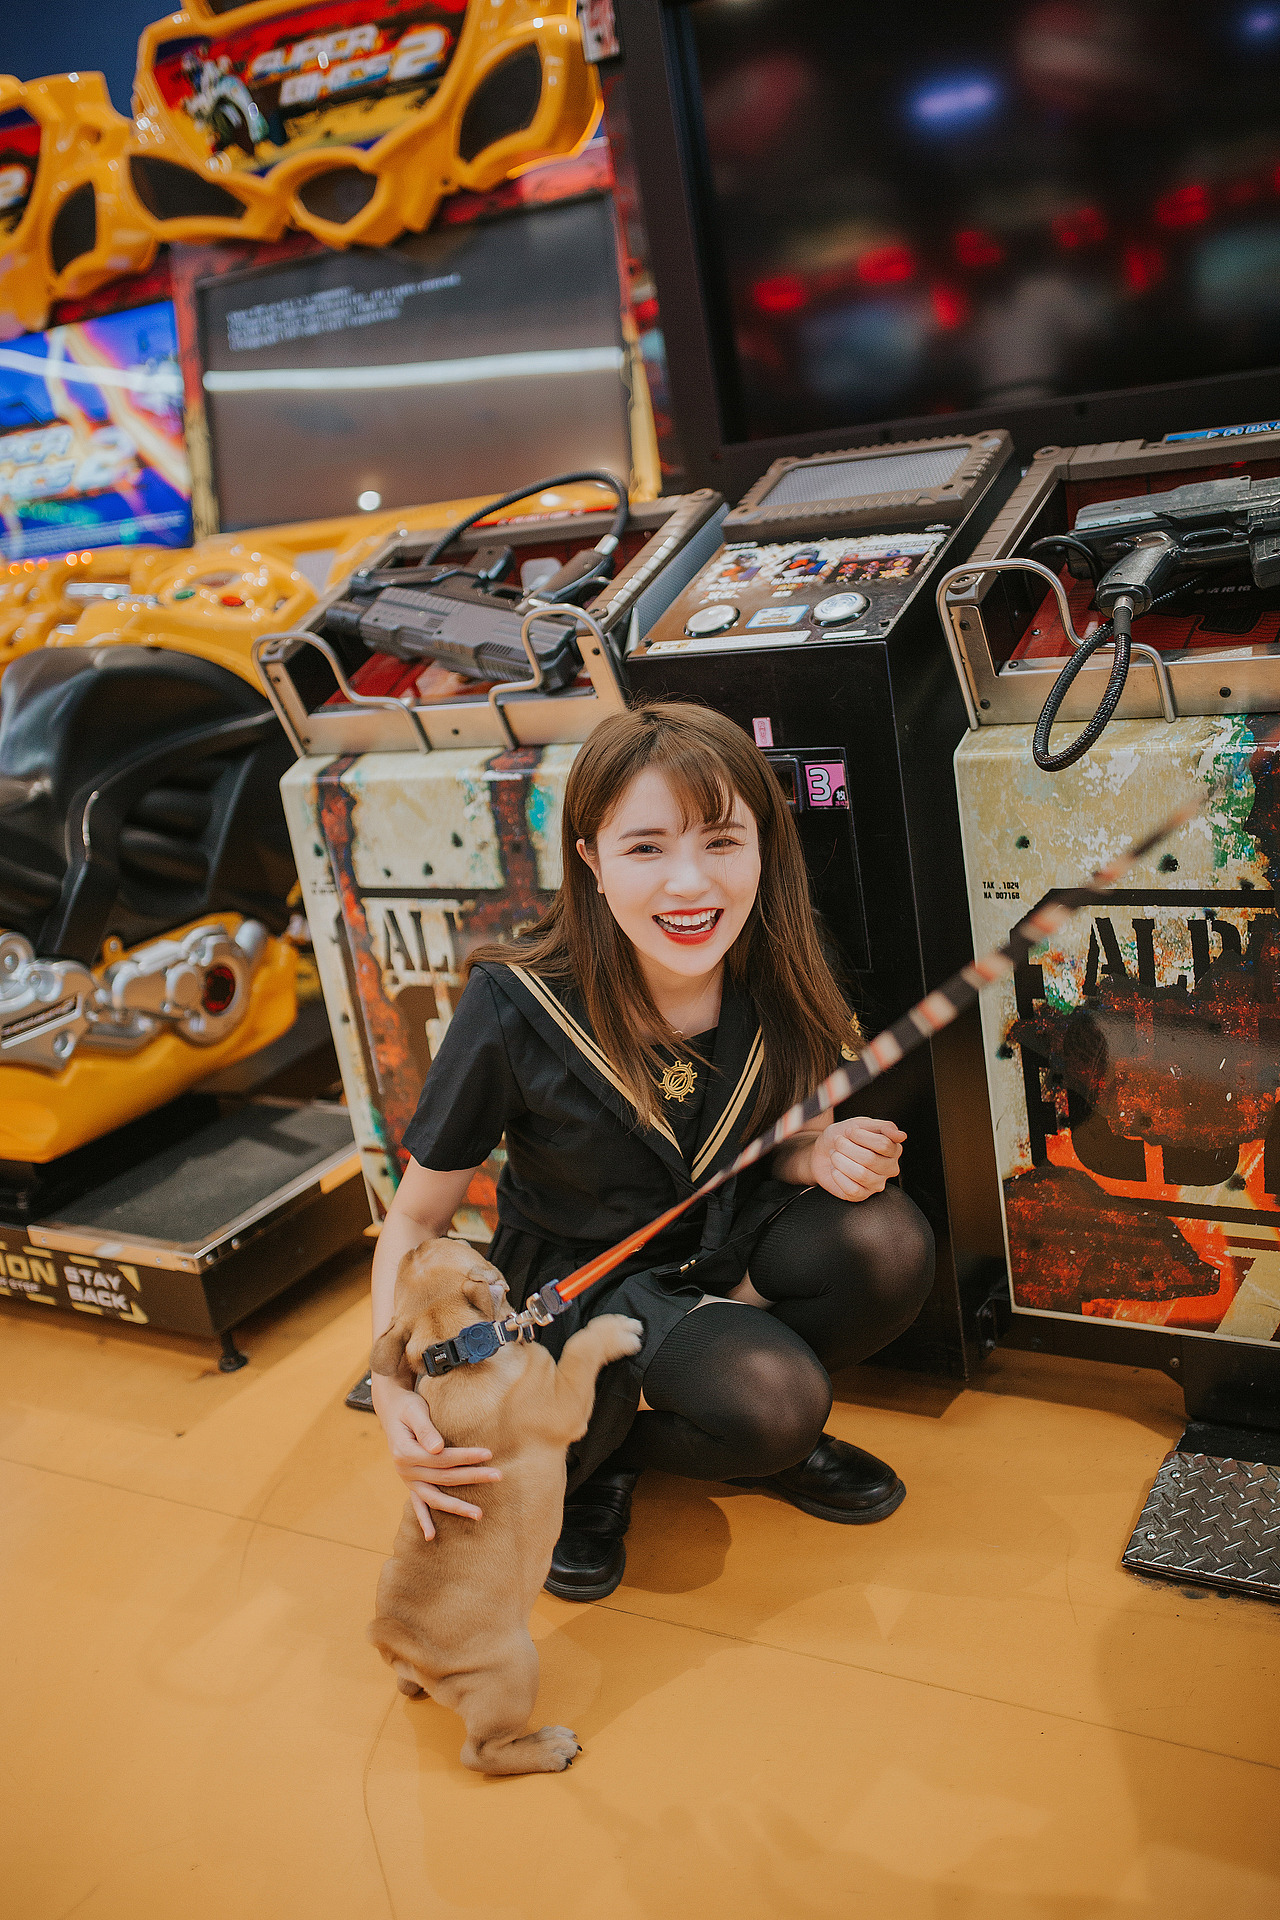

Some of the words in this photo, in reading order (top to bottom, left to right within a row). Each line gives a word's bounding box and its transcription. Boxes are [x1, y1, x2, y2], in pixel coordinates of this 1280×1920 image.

[250, 24, 379, 80] SUPER
[390, 27, 446, 81] 2
[808, 766, 832, 801] 3
[63, 1265, 121, 1291] STAY
[67, 1283, 130, 1312] BACK
